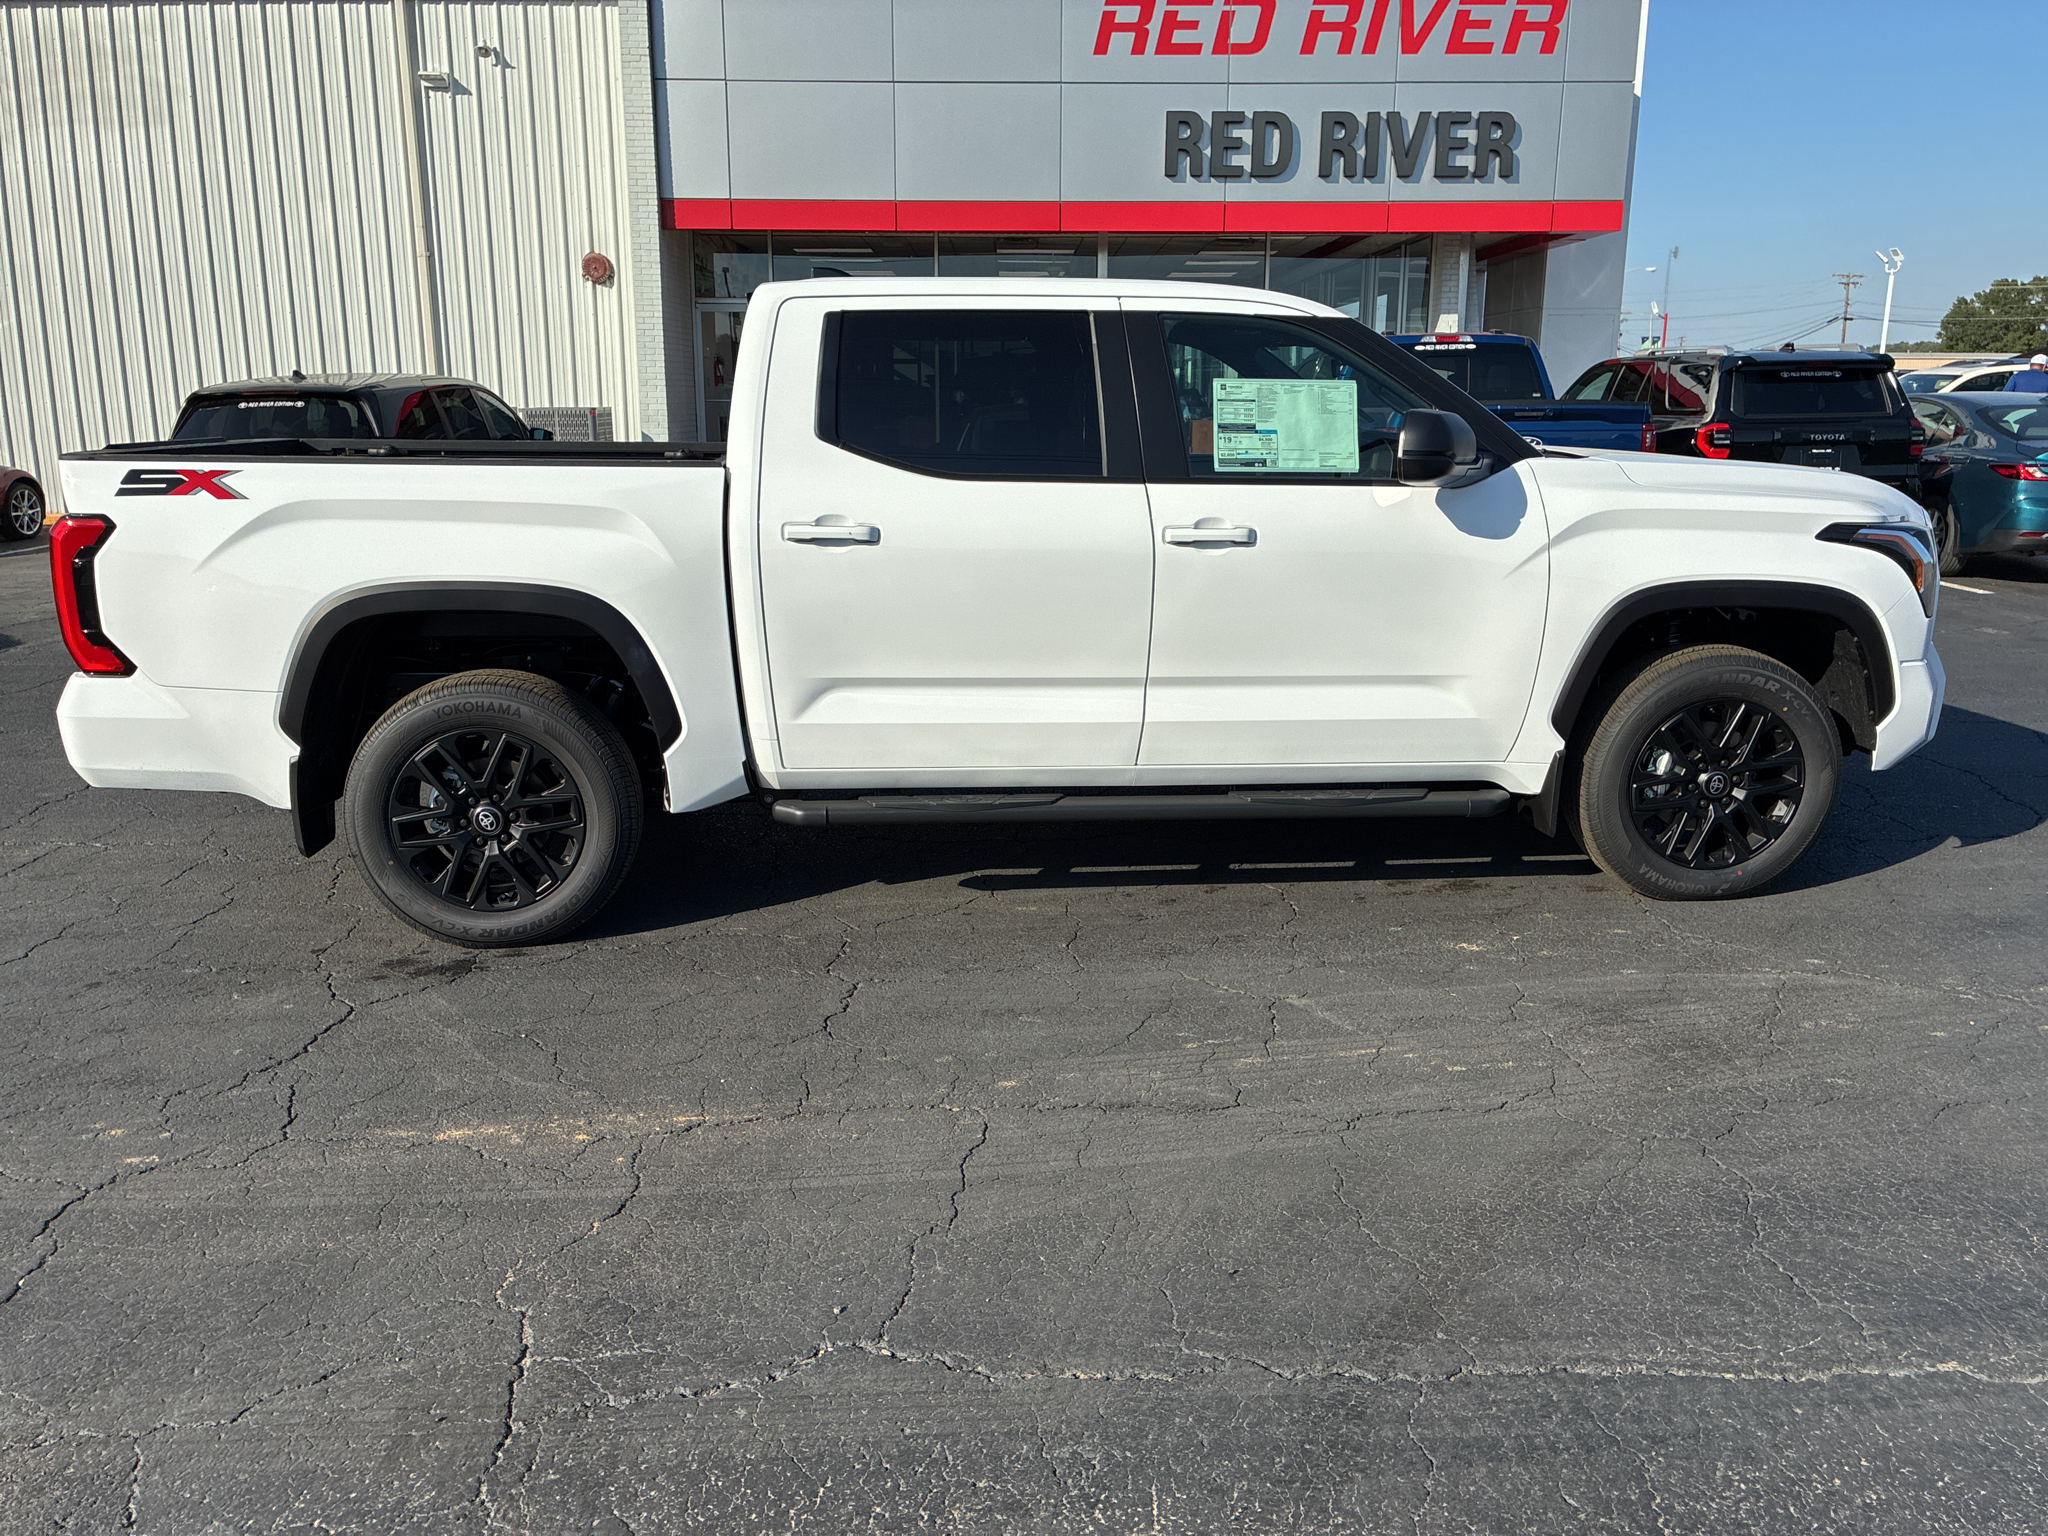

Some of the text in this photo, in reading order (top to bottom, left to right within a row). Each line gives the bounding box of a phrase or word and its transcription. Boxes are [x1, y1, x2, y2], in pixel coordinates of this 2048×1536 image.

[1092, 0, 1568, 55] RED RIVER
[1165, 110, 1517, 178] RED RIVER
[1223, 436, 1232, 444] 19
[1810, 433, 1846, 441] TOYOTA
[432, 701, 522, 719] YOKOHAMA
[1638, 863, 1713, 895] YOKOHAMA
[479, 870, 599, 939] GEOLANDAR
[431, 919, 474, 937] X-CV
